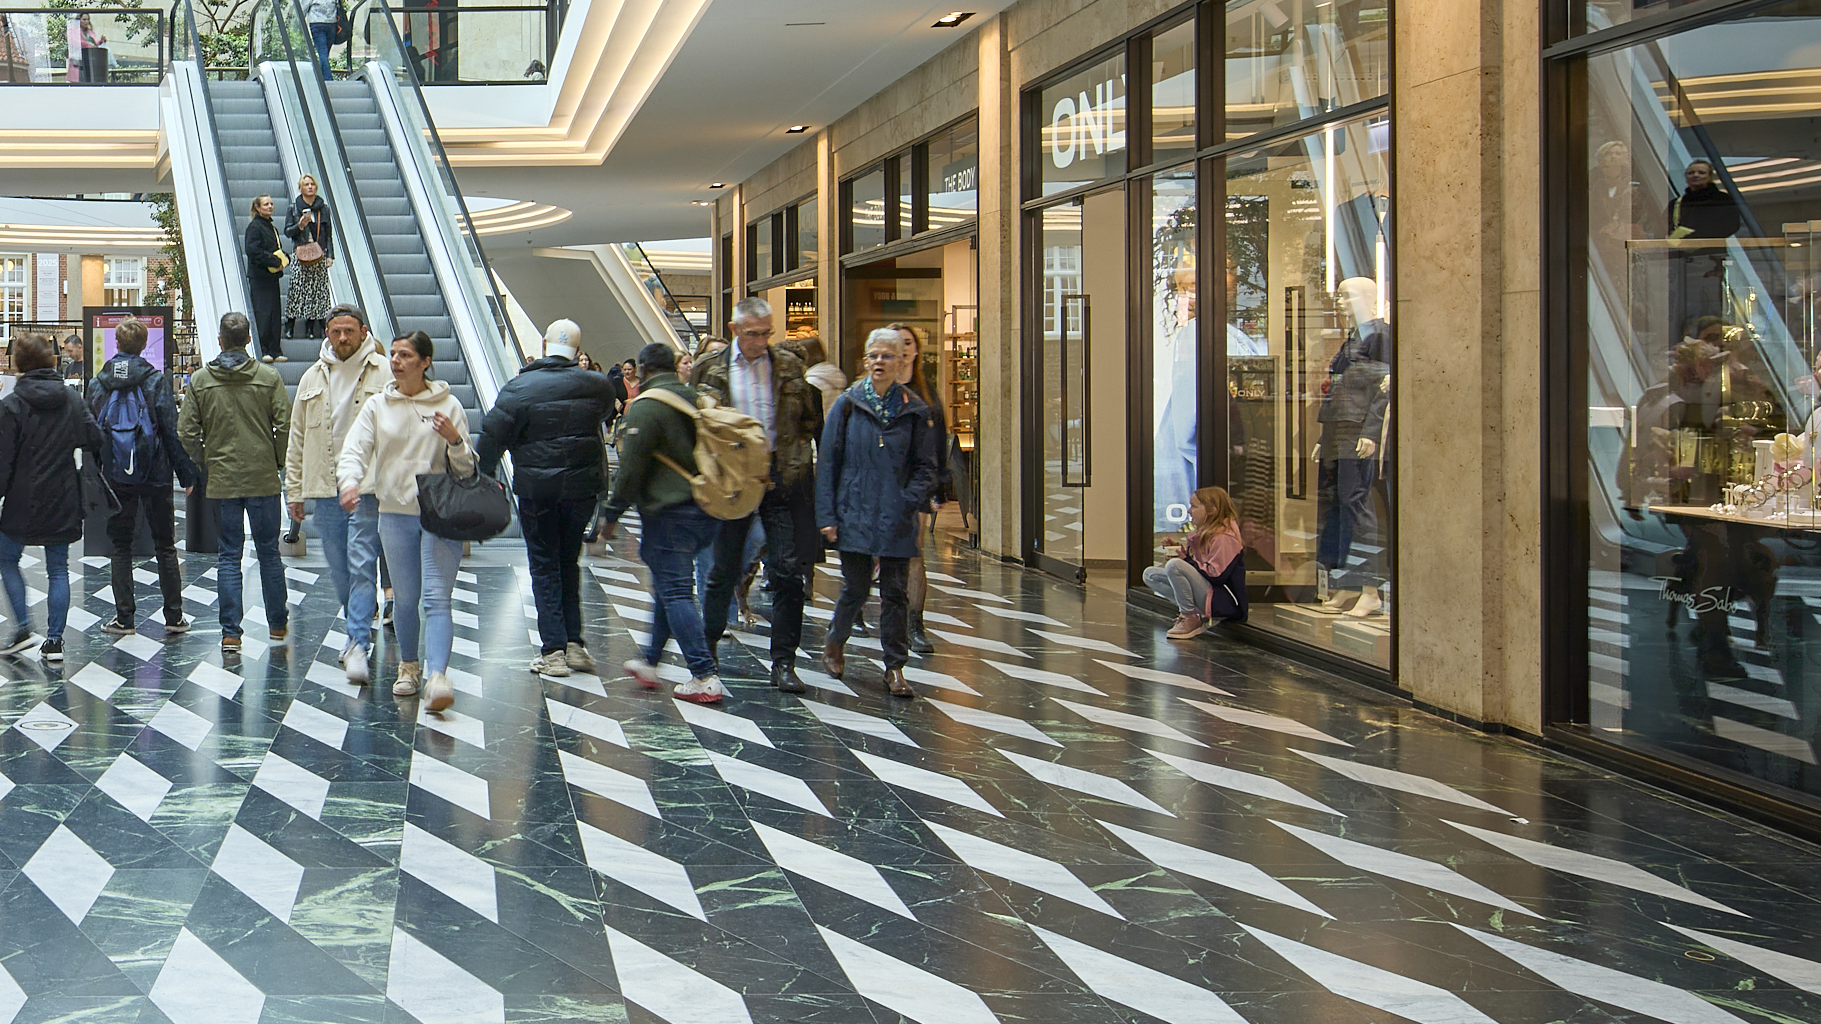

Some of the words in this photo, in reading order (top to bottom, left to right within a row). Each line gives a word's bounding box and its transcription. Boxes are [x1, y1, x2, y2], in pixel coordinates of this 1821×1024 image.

[1051, 74, 1126, 169] ONL
[944, 174, 957, 193] THE
[958, 166, 976, 192] BODY
[38, 258, 58, 267] 2025
[1237, 389, 1266, 398] ONLY
[1647, 576, 1697, 610] Thomas
[1693, 585, 1739, 614] Sabo
